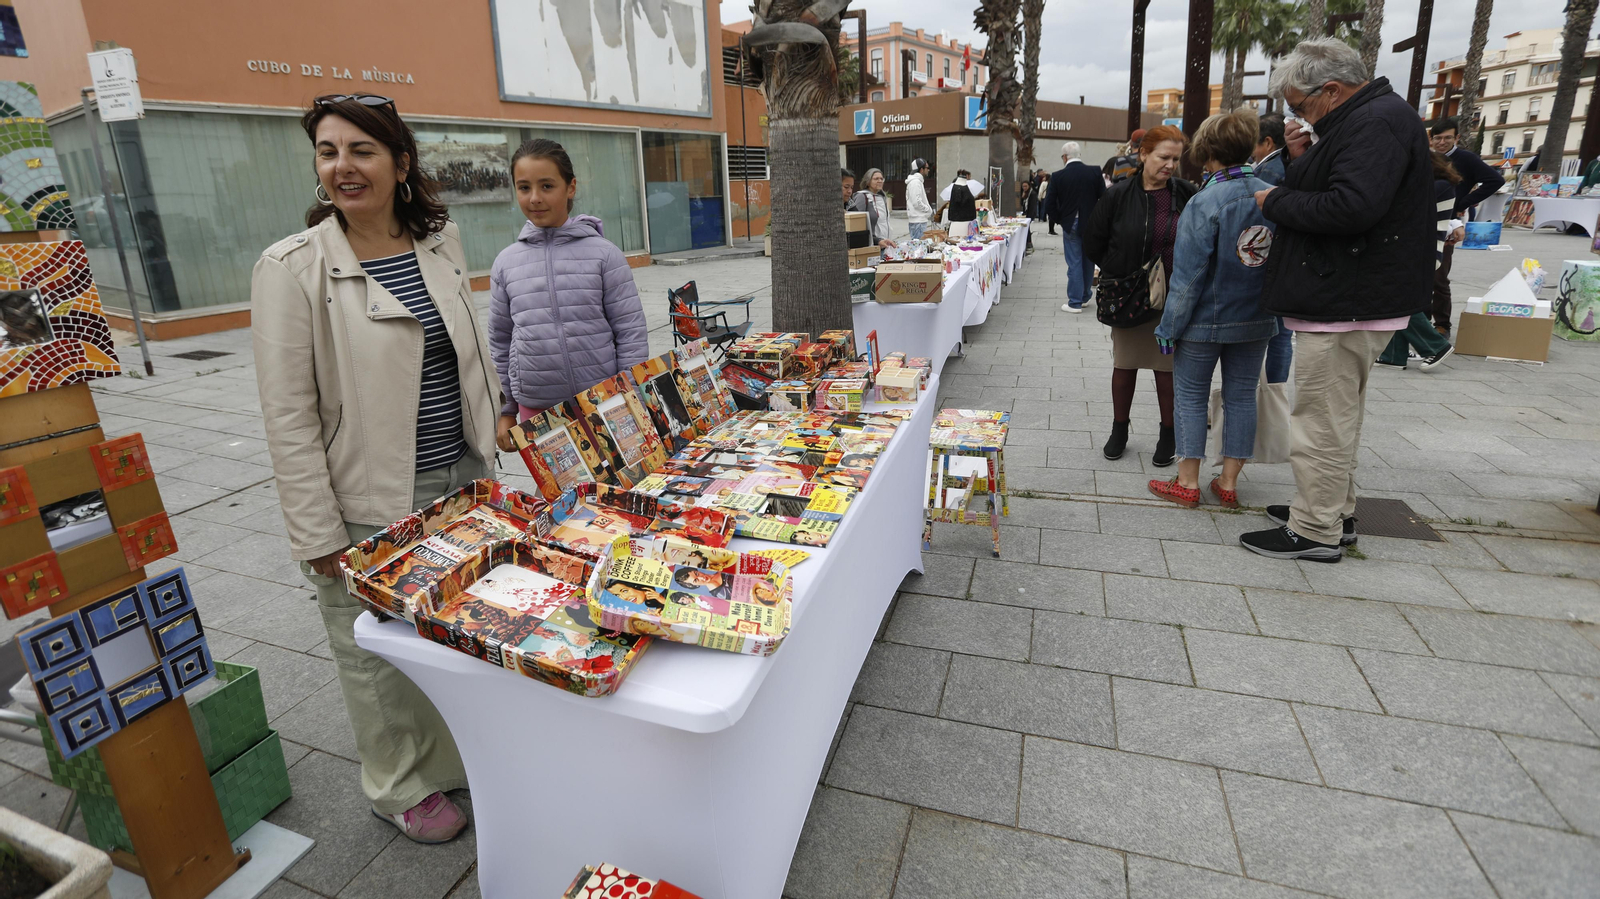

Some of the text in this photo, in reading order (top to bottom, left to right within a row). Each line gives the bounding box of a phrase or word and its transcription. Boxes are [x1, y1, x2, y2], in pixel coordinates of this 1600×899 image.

[247, 60, 291, 74] CUBO
[300, 64, 323, 77] DE
[332, 67, 352, 80] LA
[882, 114, 910, 124] Oficina
[1036, 118, 1071, 130] Turismo
[890, 123, 922, 132] Turismo
[610, 558, 624, 578] DRINK
[621, 556, 636, 579] COFFEE
[732, 603, 741, 615] Make
[742, 604, 752, 621] ourself
